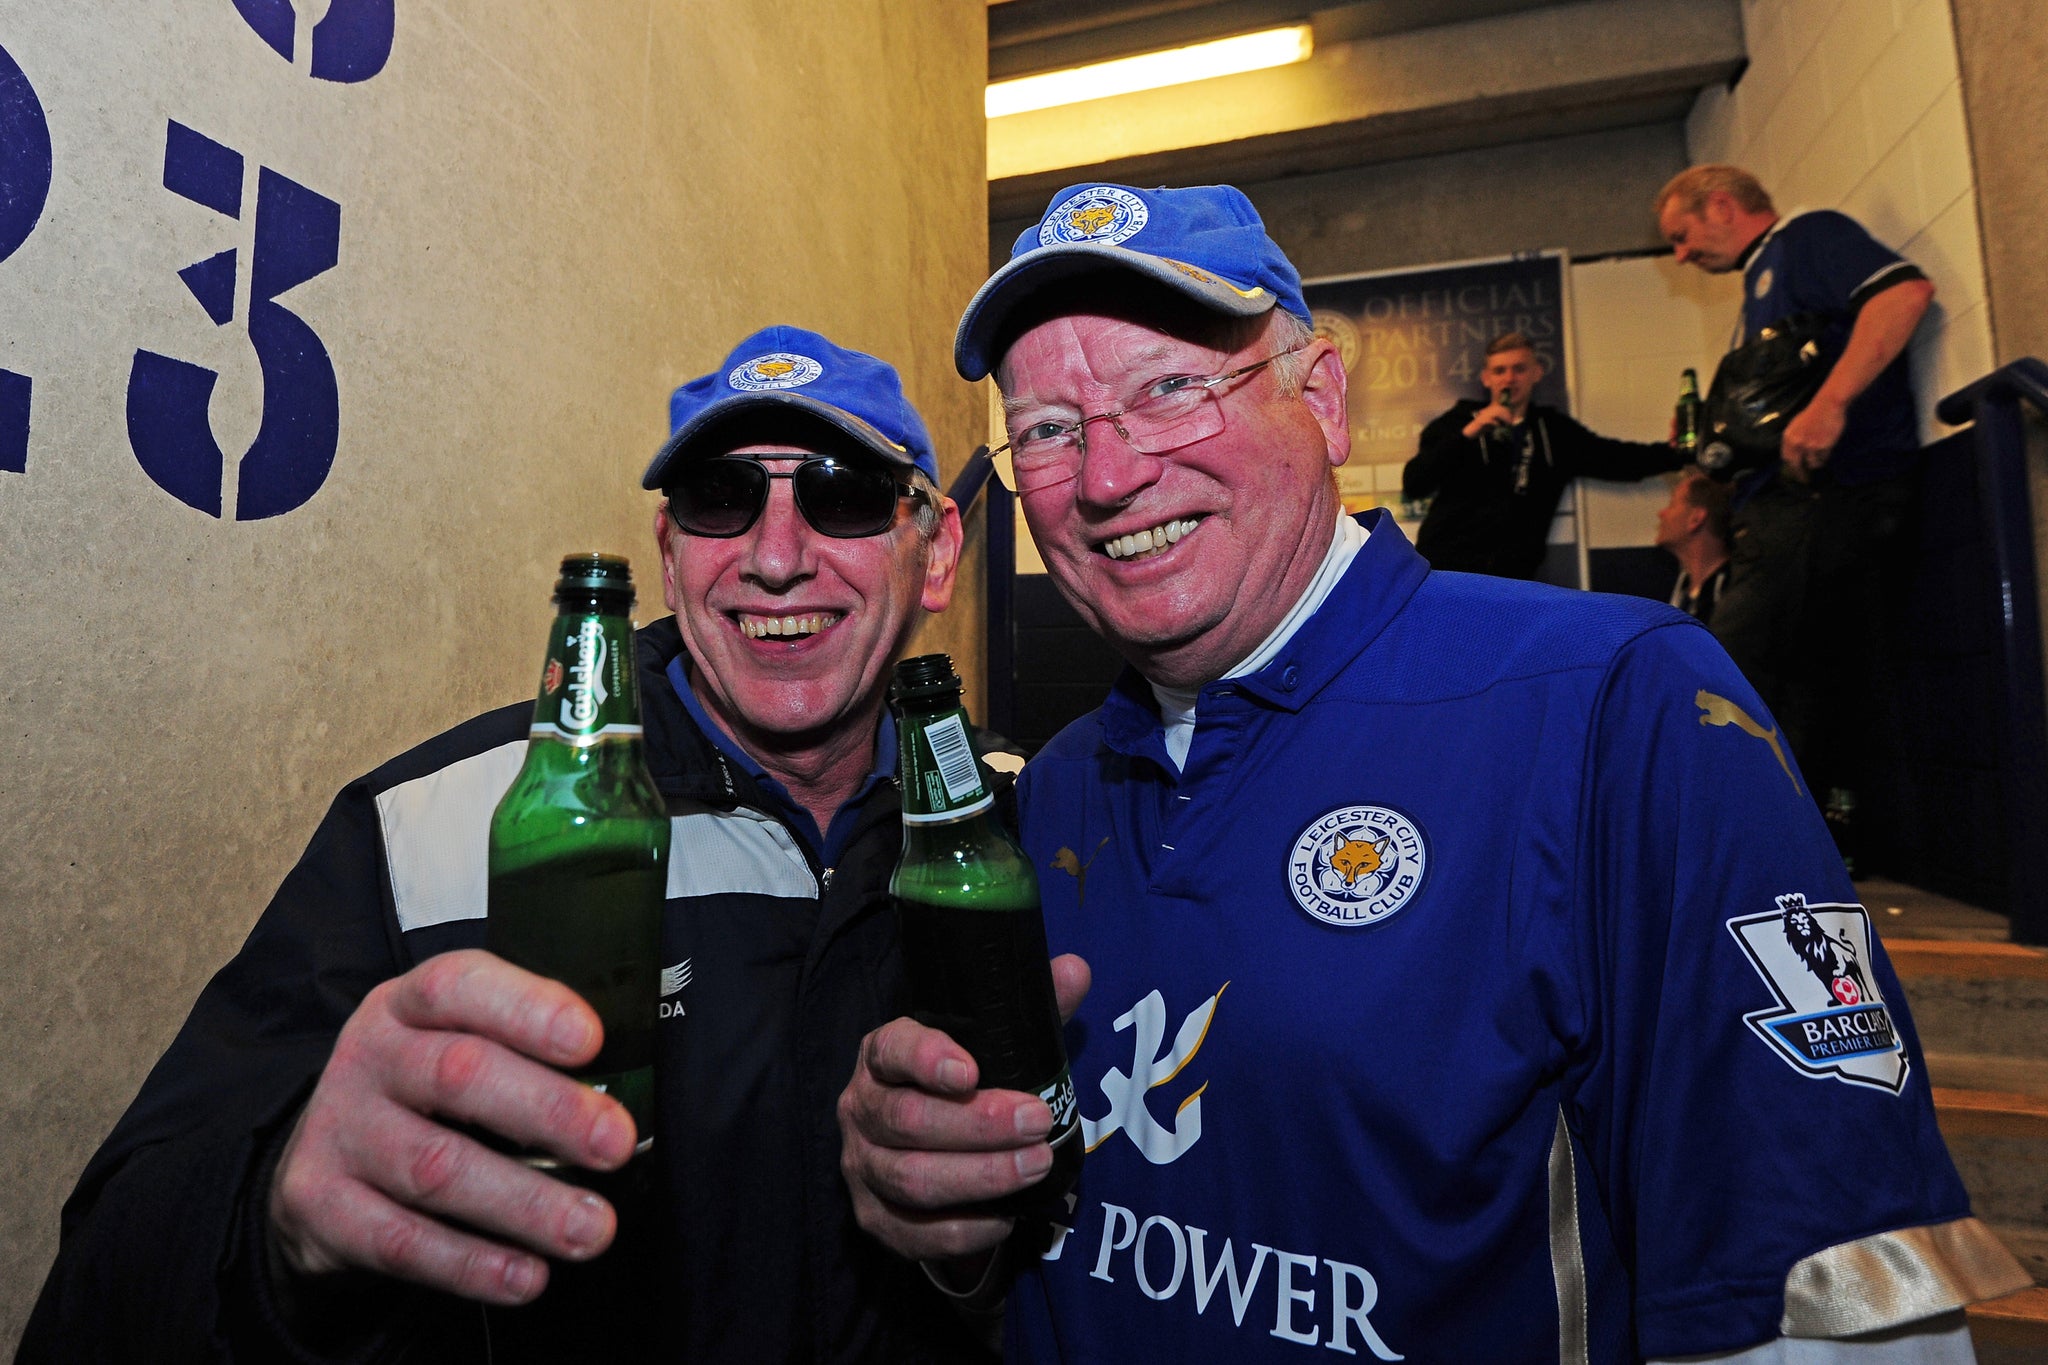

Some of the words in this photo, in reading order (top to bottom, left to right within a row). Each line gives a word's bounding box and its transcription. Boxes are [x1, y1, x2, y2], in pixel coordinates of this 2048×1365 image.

[1044, 188, 1116, 228] LEICESTER
[1120, 193, 1146, 213] CITY
[1112, 220, 1144, 243] CLUB
[1363, 279, 1552, 321] OFFICIAL
[1364, 313, 1555, 354] PARTNERS
[790, 372, 818, 386] CLUB
[560, 621, 609, 730] Carlsberg
[1301, 810, 1398, 852] LEICESTER
[1396, 825, 1420, 865] CITY
[1294, 862, 1367, 920] FOOTBALL
[1369, 874, 1414, 915] CLUB
[1810, 1035, 1874, 1058] PREMIER
[1089, 1201, 1405, 1362] POWER
